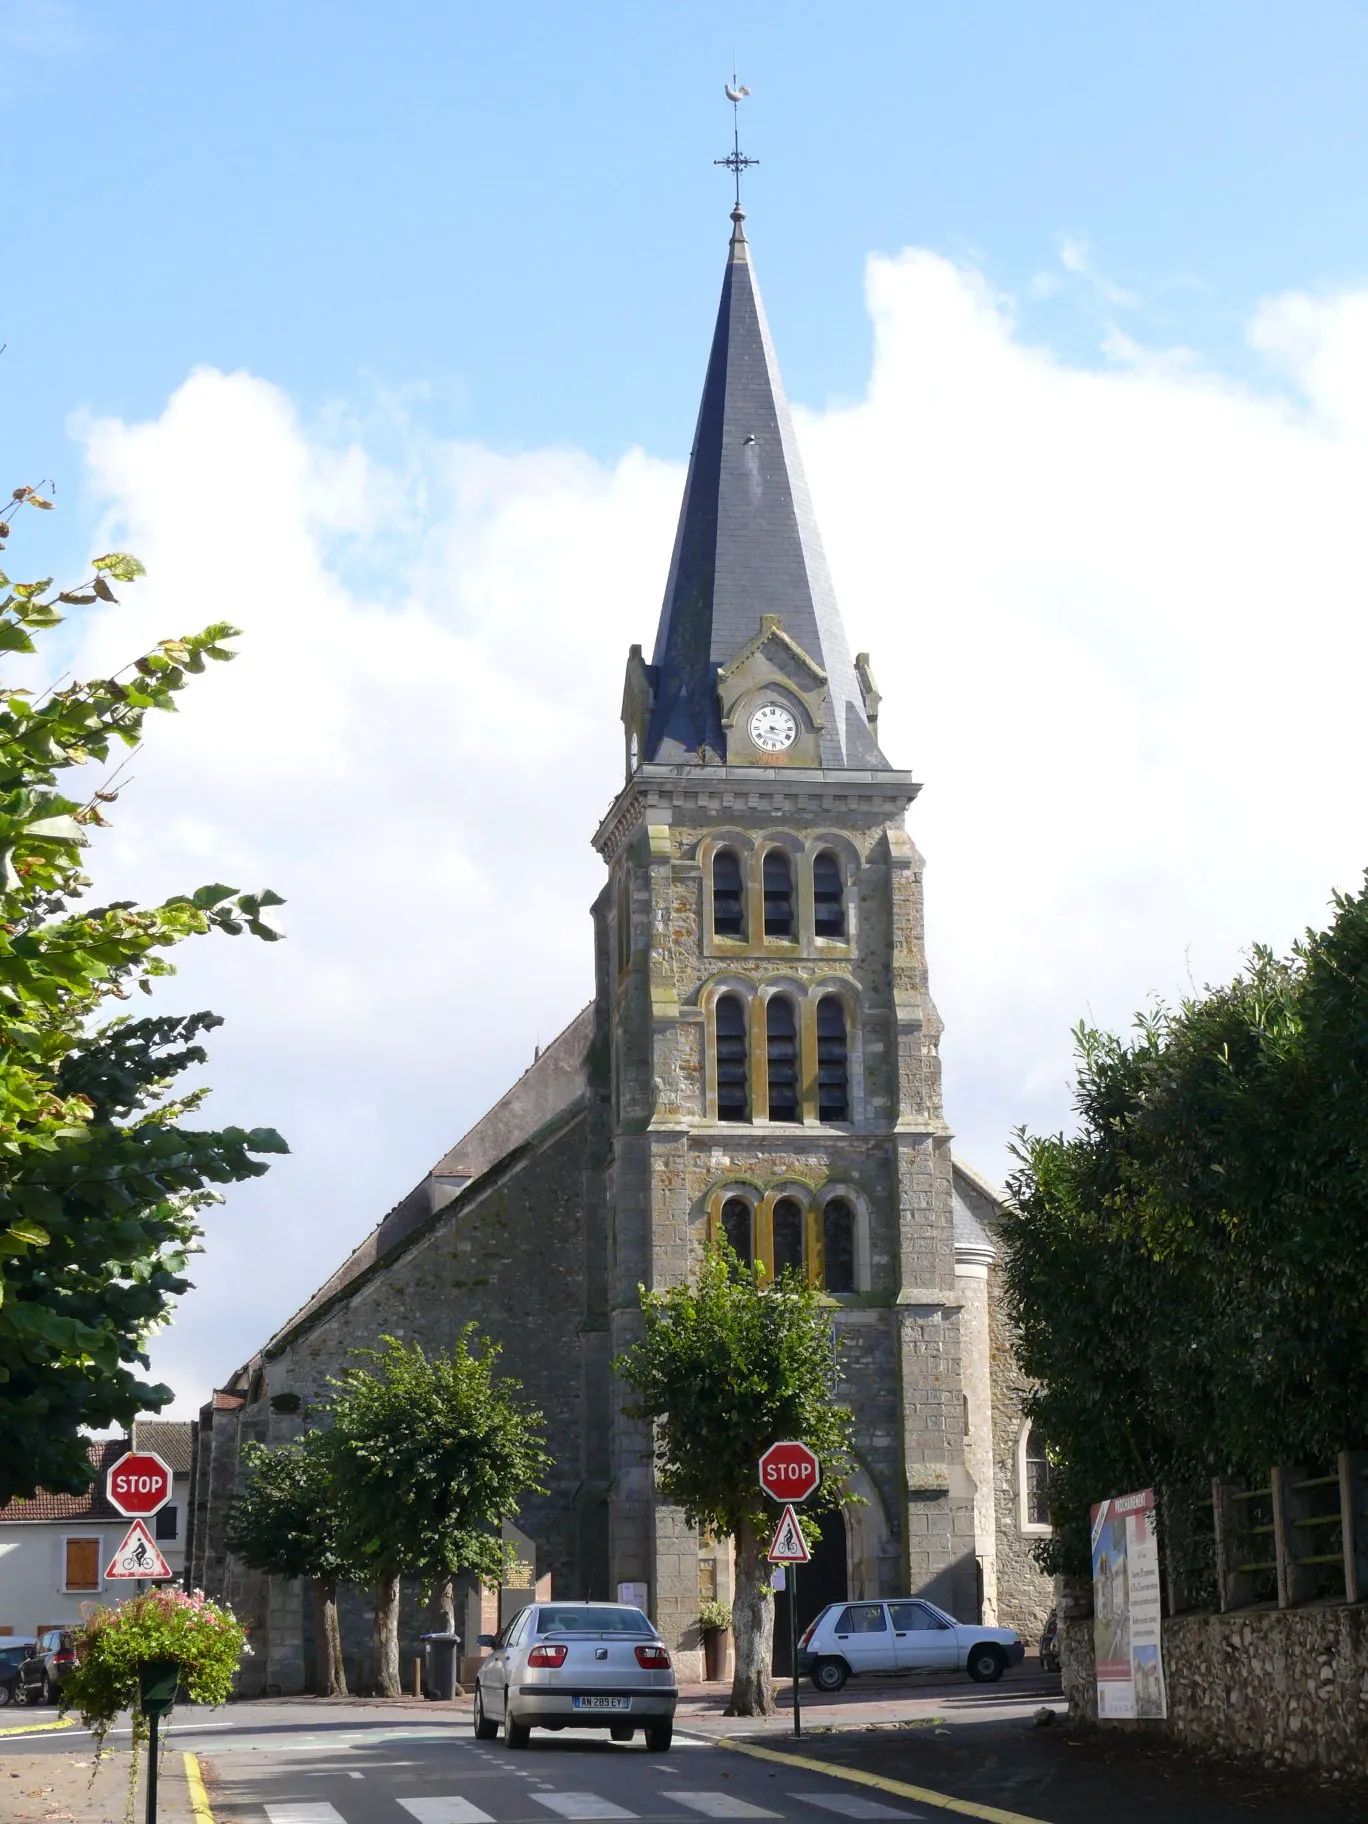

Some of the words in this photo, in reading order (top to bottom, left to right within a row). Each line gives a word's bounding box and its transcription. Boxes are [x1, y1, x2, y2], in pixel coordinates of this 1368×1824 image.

[766, 1463, 812, 1480] STOP
[116, 1475, 163, 1493] STOP
[582, 1698, 592, 1707] AN
[594, 1698, 610, 1707] 289
[611, 1698, 621, 1707] EY
